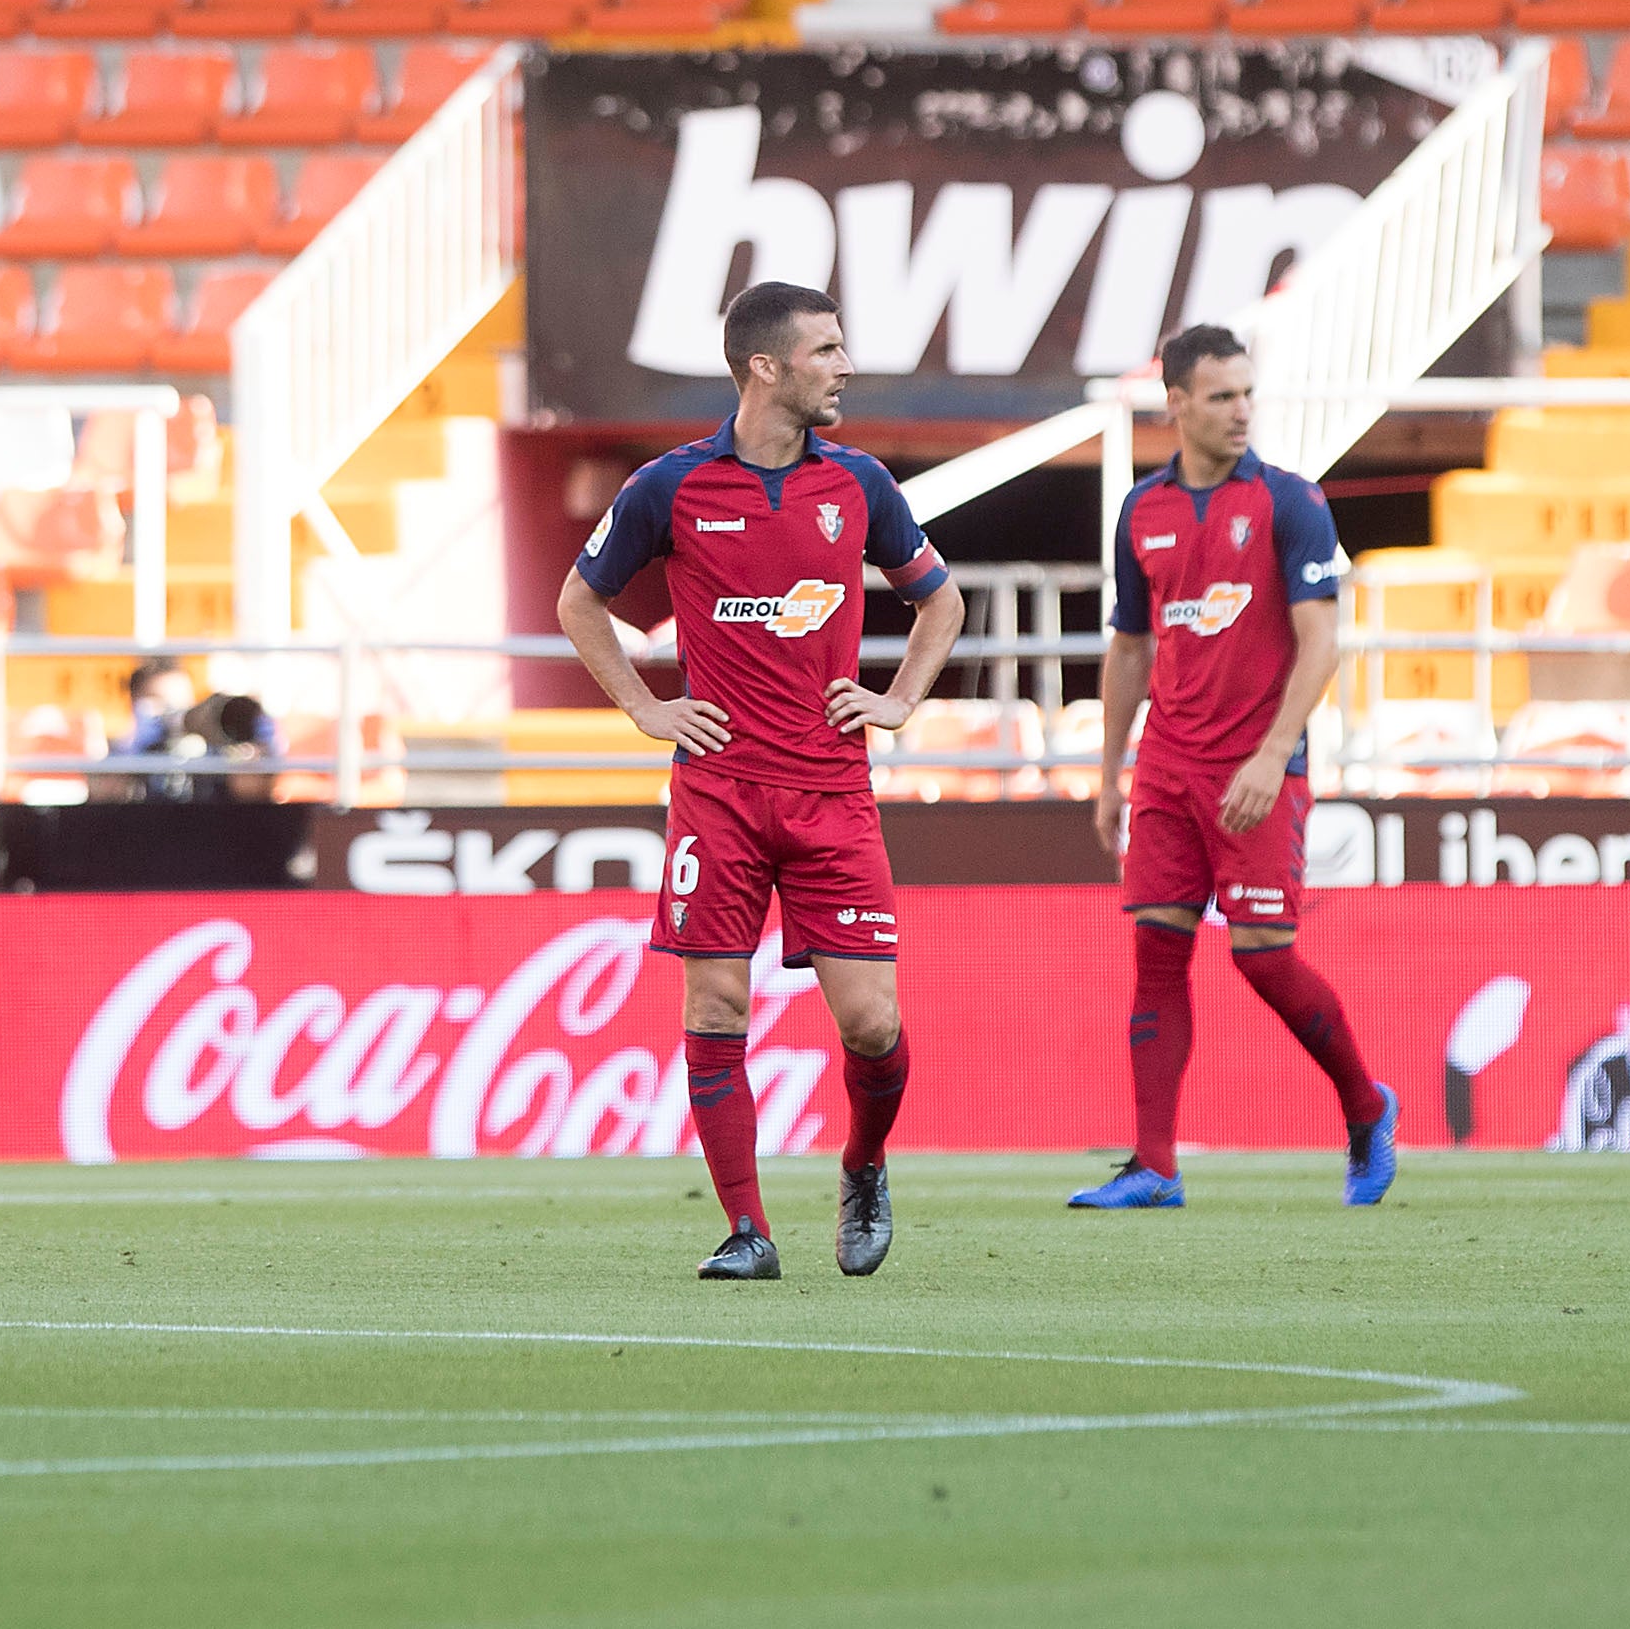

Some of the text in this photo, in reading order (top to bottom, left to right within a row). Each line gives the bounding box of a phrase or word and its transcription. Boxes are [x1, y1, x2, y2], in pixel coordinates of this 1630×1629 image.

[626, 89, 1369, 376] bwin
[718, 599, 827, 619] KIROLBET
[672, 835, 700, 896] 6
